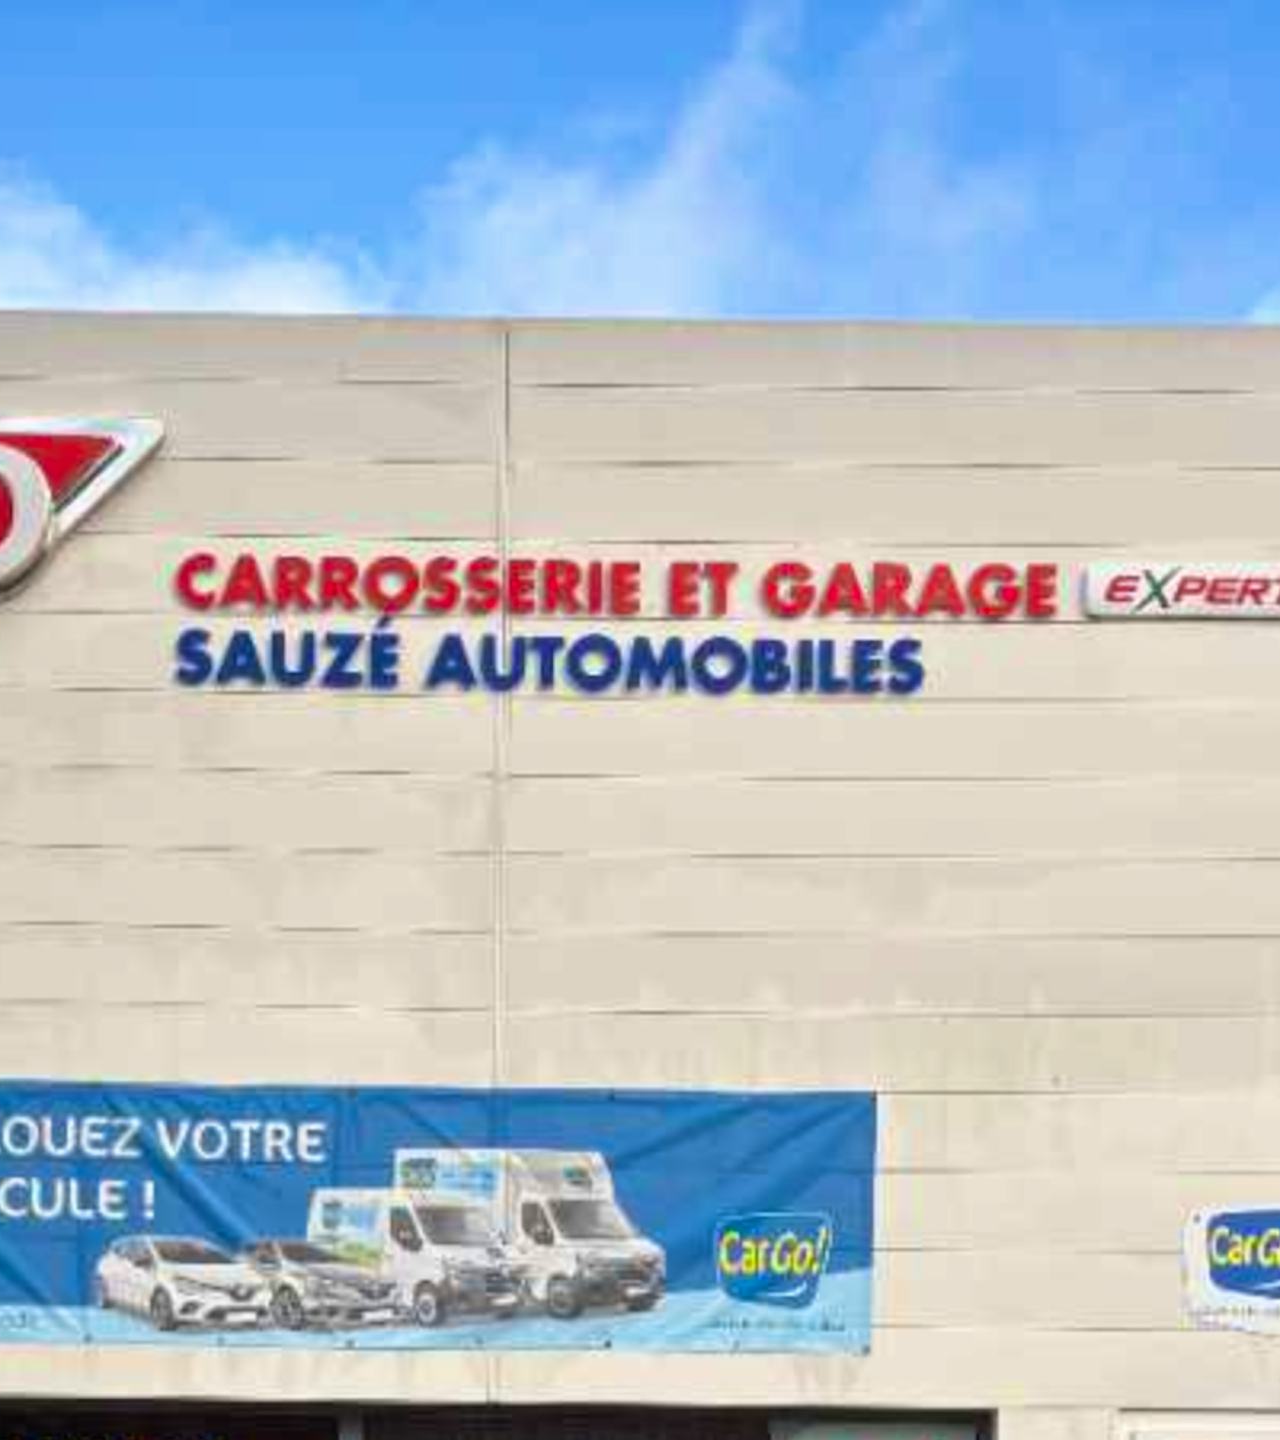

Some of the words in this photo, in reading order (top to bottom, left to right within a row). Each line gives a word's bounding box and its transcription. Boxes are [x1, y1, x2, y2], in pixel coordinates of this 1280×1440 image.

[174, 553, 642, 615] CARROSSERIE
[668, 561, 739, 616] ET
[760, 562, 1058, 618] GARAGE
[174, 614, 401, 689] SAUZÉ
[425, 634, 925, 693] AUTOMOBILES
[156, 1118, 328, 1162] VOTRE
[142, 1180, 156, 1220] !
